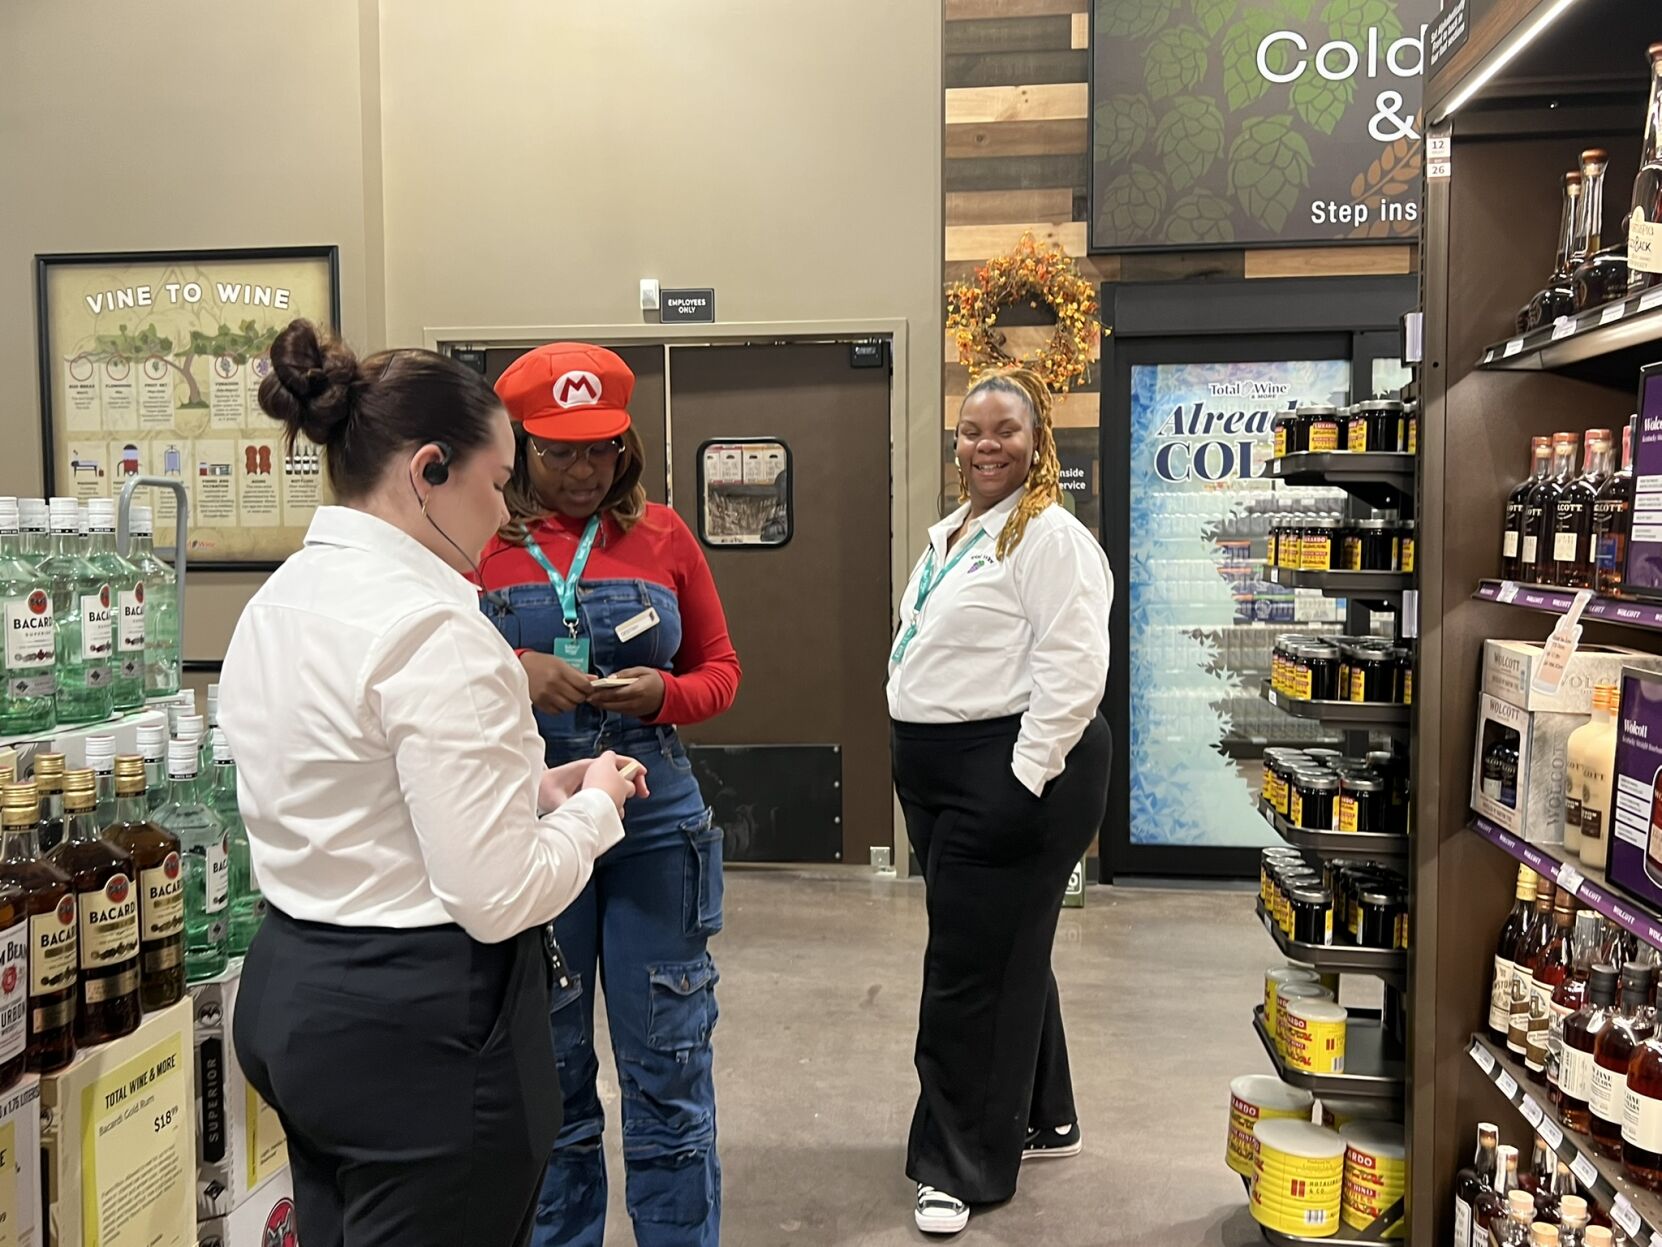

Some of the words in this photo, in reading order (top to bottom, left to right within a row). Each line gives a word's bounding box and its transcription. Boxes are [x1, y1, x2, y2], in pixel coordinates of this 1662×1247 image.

[1256, 24, 1428, 83] Cold
[1367, 90, 1421, 142] &
[1431, 140, 1445, 149] 12
[1431, 165, 1445, 174] 26
[1310, 200, 1369, 227] Step
[1380, 198, 1418, 222] ins
[86, 285, 153, 315] VINE
[165, 282, 203, 304] TO
[215, 282, 291, 310] WINE
[667, 298, 706, 307] EMPLOYEES
[678, 306, 696, 314] ONLY
[560, 375, 597, 403] M
[1210, 382, 1240, 396] Total
[1253, 382, 1288, 395] Wine
[1156, 440, 1267, 482] COL
[1059, 468, 1085, 478] nside
[1058, 480, 1086, 490] ervice
[1526, 595, 1544, 604] WOLCOTT
[1616, 609, 1641, 618] WOLCOTT
[1494, 652, 1520, 672] WOLCOTT
[1489, 700, 1520, 720] WOLCOTT
[1624, 719, 1648, 738] Wolcott
[1499, 833, 1515, 848] WOLCOTT
[1523, 850, 1541, 865] WOLCOTT
[1580, 885, 1601, 903] WOLCOTT
[89, 902, 135, 924] BACARD
[1612, 905, 1635, 924] WOLCOTT
[105, 1088, 128, 1110] TOTAL
[129, 1076, 148, 1097] WINE
[148, 1070, 156, 1084] &
[156, 1053, 177, 1078] MORE
[8, 1096, 20, 1114] 1.75
[140, 1095, 155, 1110] Rum
[208, 1057, 219, 1144] SUPERIOR
